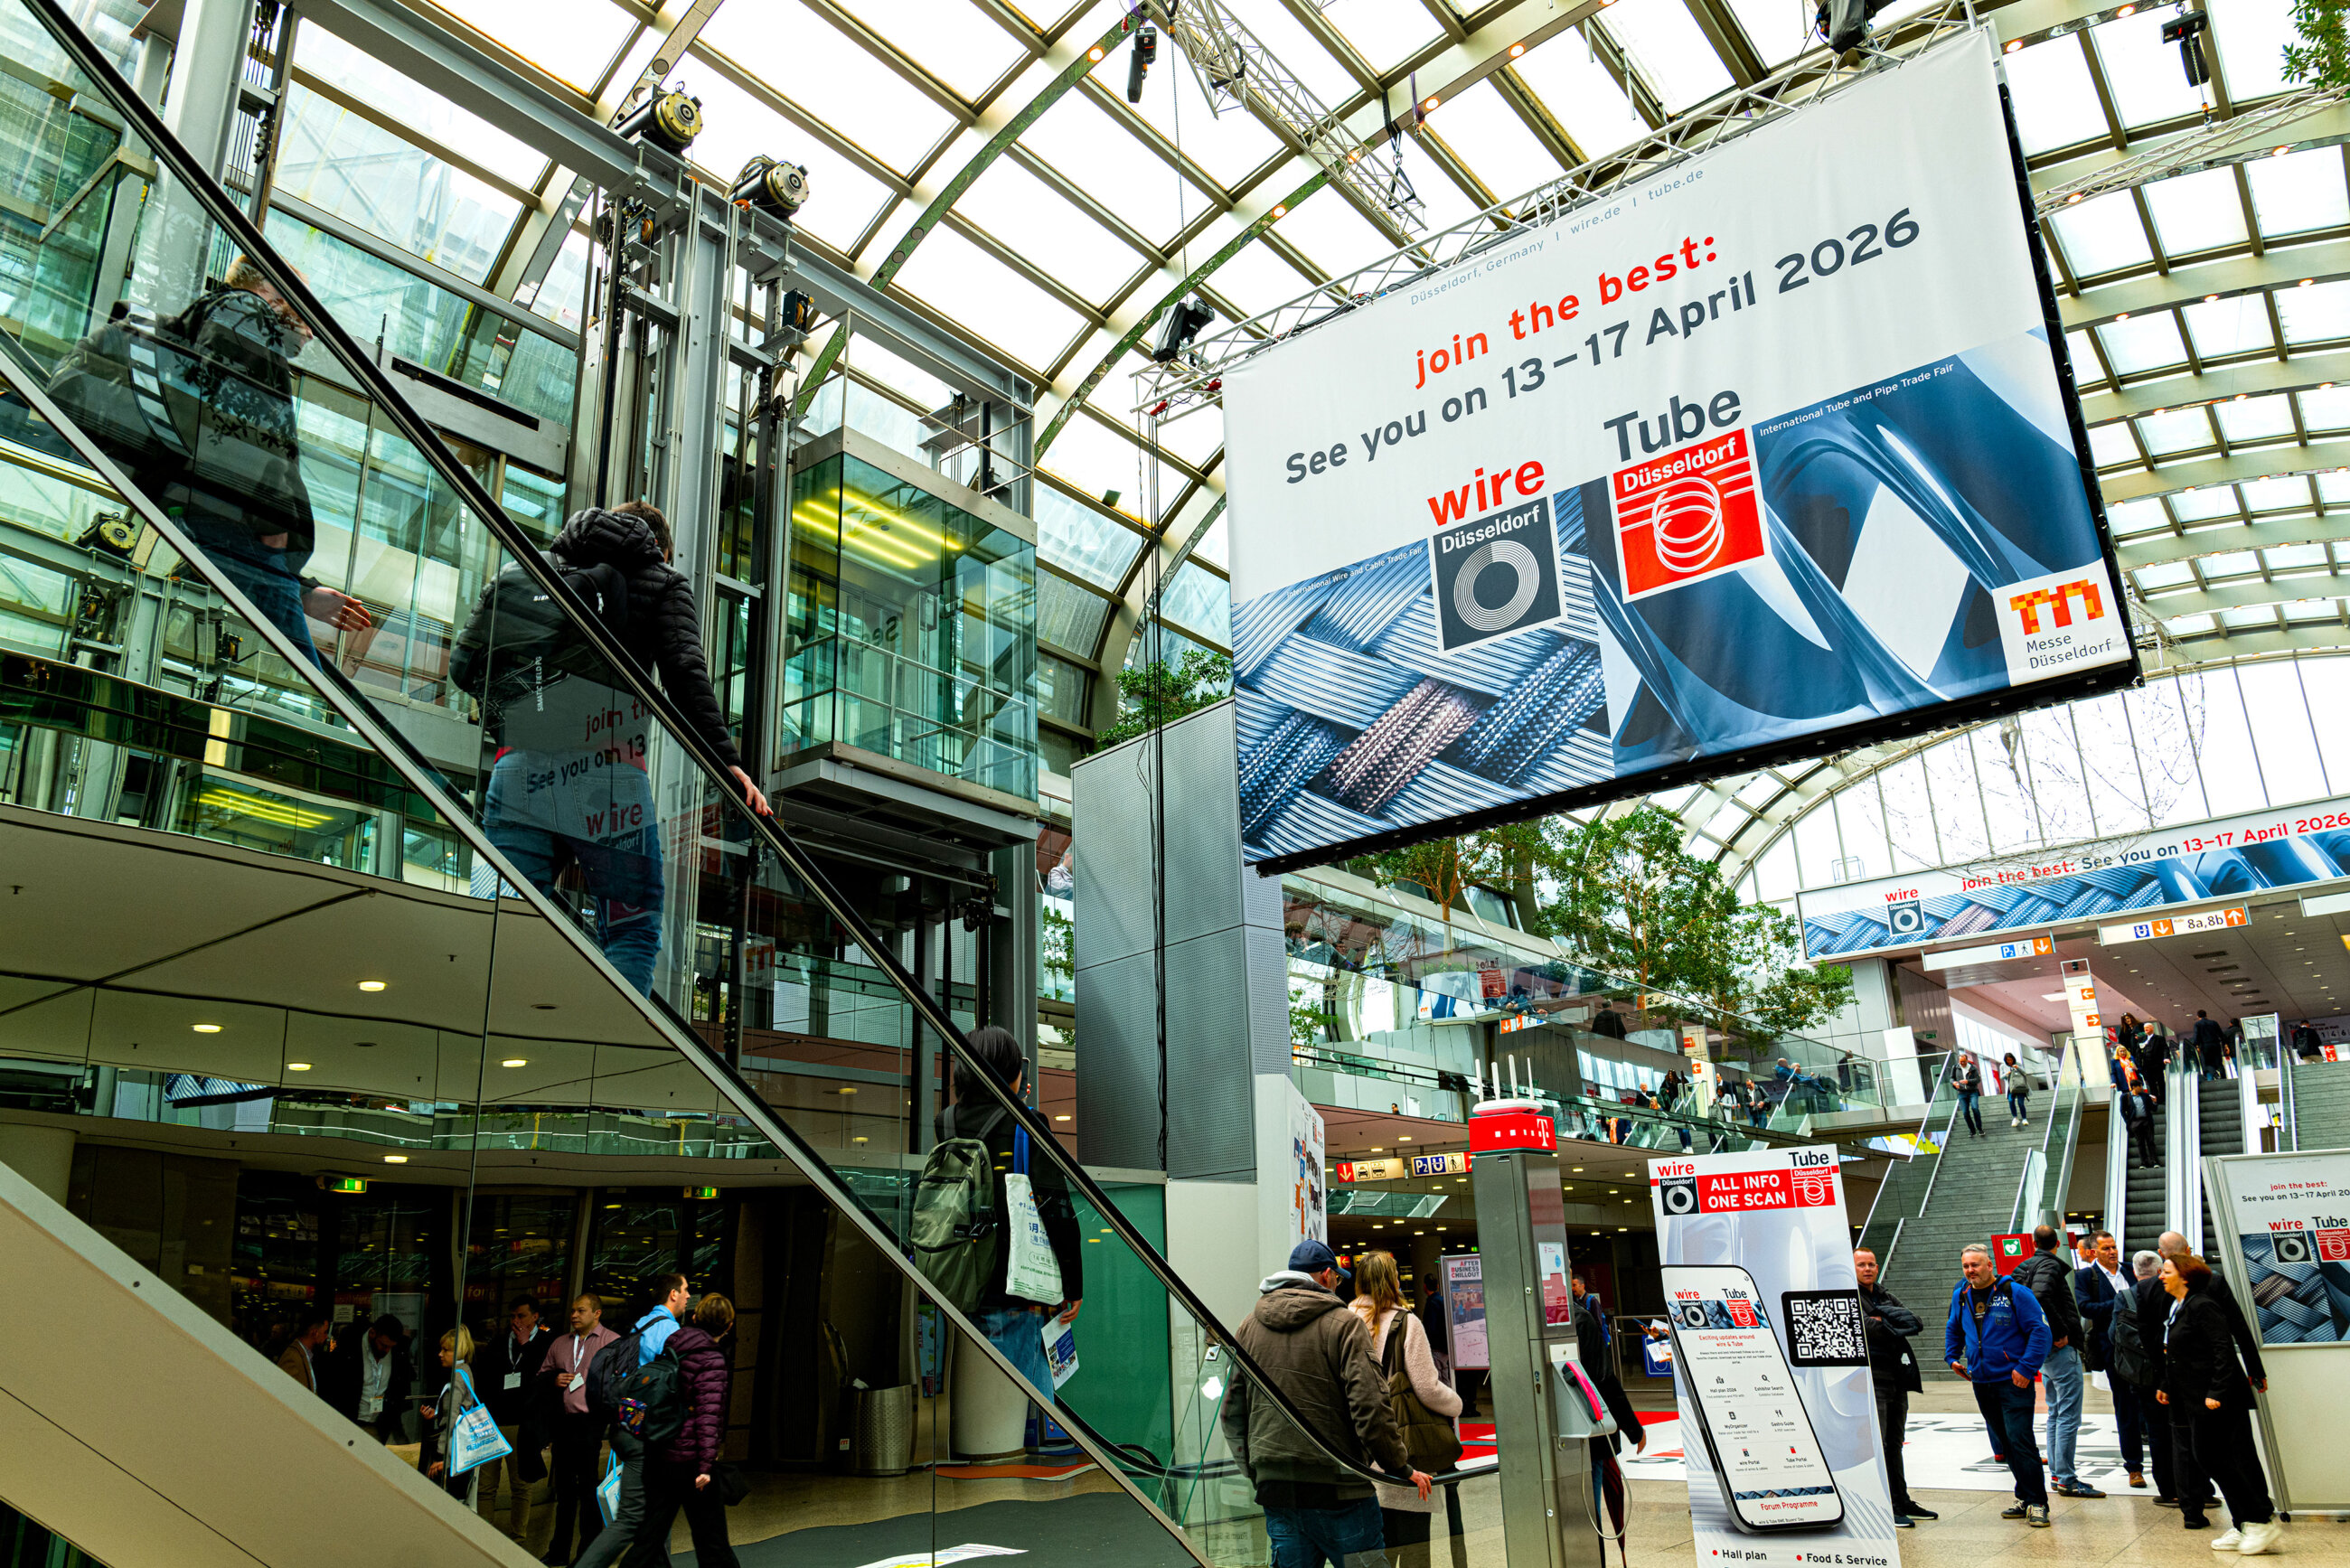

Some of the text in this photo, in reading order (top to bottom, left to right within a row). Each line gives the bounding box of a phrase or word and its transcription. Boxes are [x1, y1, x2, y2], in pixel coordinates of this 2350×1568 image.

[1410, 268, 1482, 305] Düsseldorf,
[1486, 239, 1545, 273] Germany
[1570, 206, 1622, 235] wire.de
[1648, 169, 1705, 201] tube.de
[1415, 236, 1717, 390] join the best:
[1286, 443, 1348, 484] See
[1360, 409, 1426, 462] you
[1442, 387, 1488, 422] on
[1646, 269, 1756, 346] April
[1774, 207, 1920, 295] 2026
[1760, 362, 1954, 437] International Tube and Pipe Trade Fair
[1603, 390, 1742, 463] Tube
[1622, 437, 1736, 493] Düsseldorf
[1427, 461, 1546, 527] wire
[1441, 505, 1540, 554] Düsseldorf
[1332, 572, 1349, 583] Wire
[1349, 567, 1363, 577] and
[1364, 559, 1385, 571] Cable
[1387, 551, 1407, 564] Trade
[1409, 545, 1423, 557] Fair
[2026, 634, 2072, 653] Messe
[2029, 638, 2111, 669] Düsseldorf
[561, 756, 588, 786] you
[627, 734, 646, 760] 13
[586, 803, 644, 837] wire
[1962, 876, 1992, 892] join
[1998, 870, 2026, 884] the
[2032, 860, 2075, 878] best:
[2082, 857, 2112, 869] See
[2120, 850, 2151, 865] you
[2157, 845, 2178, 856] on
[2243, 822, 2289, 843] April
[2295, 812, 2350, 833] 2026
[1885, 888, 1919, 902] wire
[1788, 1151, 1829, 1167] Tube
[1658, 1161, 1695, 1177] wire
[1794, 1168, 1828, 1177] Düsseldorf
[1661, 1178, 1693, 1187] Düsseldorf
[1710, 1174, 1780, 1192] ALL INFO
[2270, 1183, 2286, 1191] join
[2306, 1180, 2327, 1188] best:
[1708, 1191, 1787, 1208] ONE SCAN
[2260, 1194, 2275, 1202] you
[2316, 1189, 2336, 1198] April
[2268, 1218, 2303, 1231] wire
[2311, 1216, 2348, 1228] Tube
[1674, 1289, 1700, 1300] wire
[1722, 1288, 1748, 1299] Tube
[1849, 1298, 1866, 1357] SCAN FOR MORE
[1760, 1501, 1819, 1511] Forum Programme
[1722, 1549, 1767, 1561] Hall plan
[1807, 1554, 1888, 1566] Food & Service
